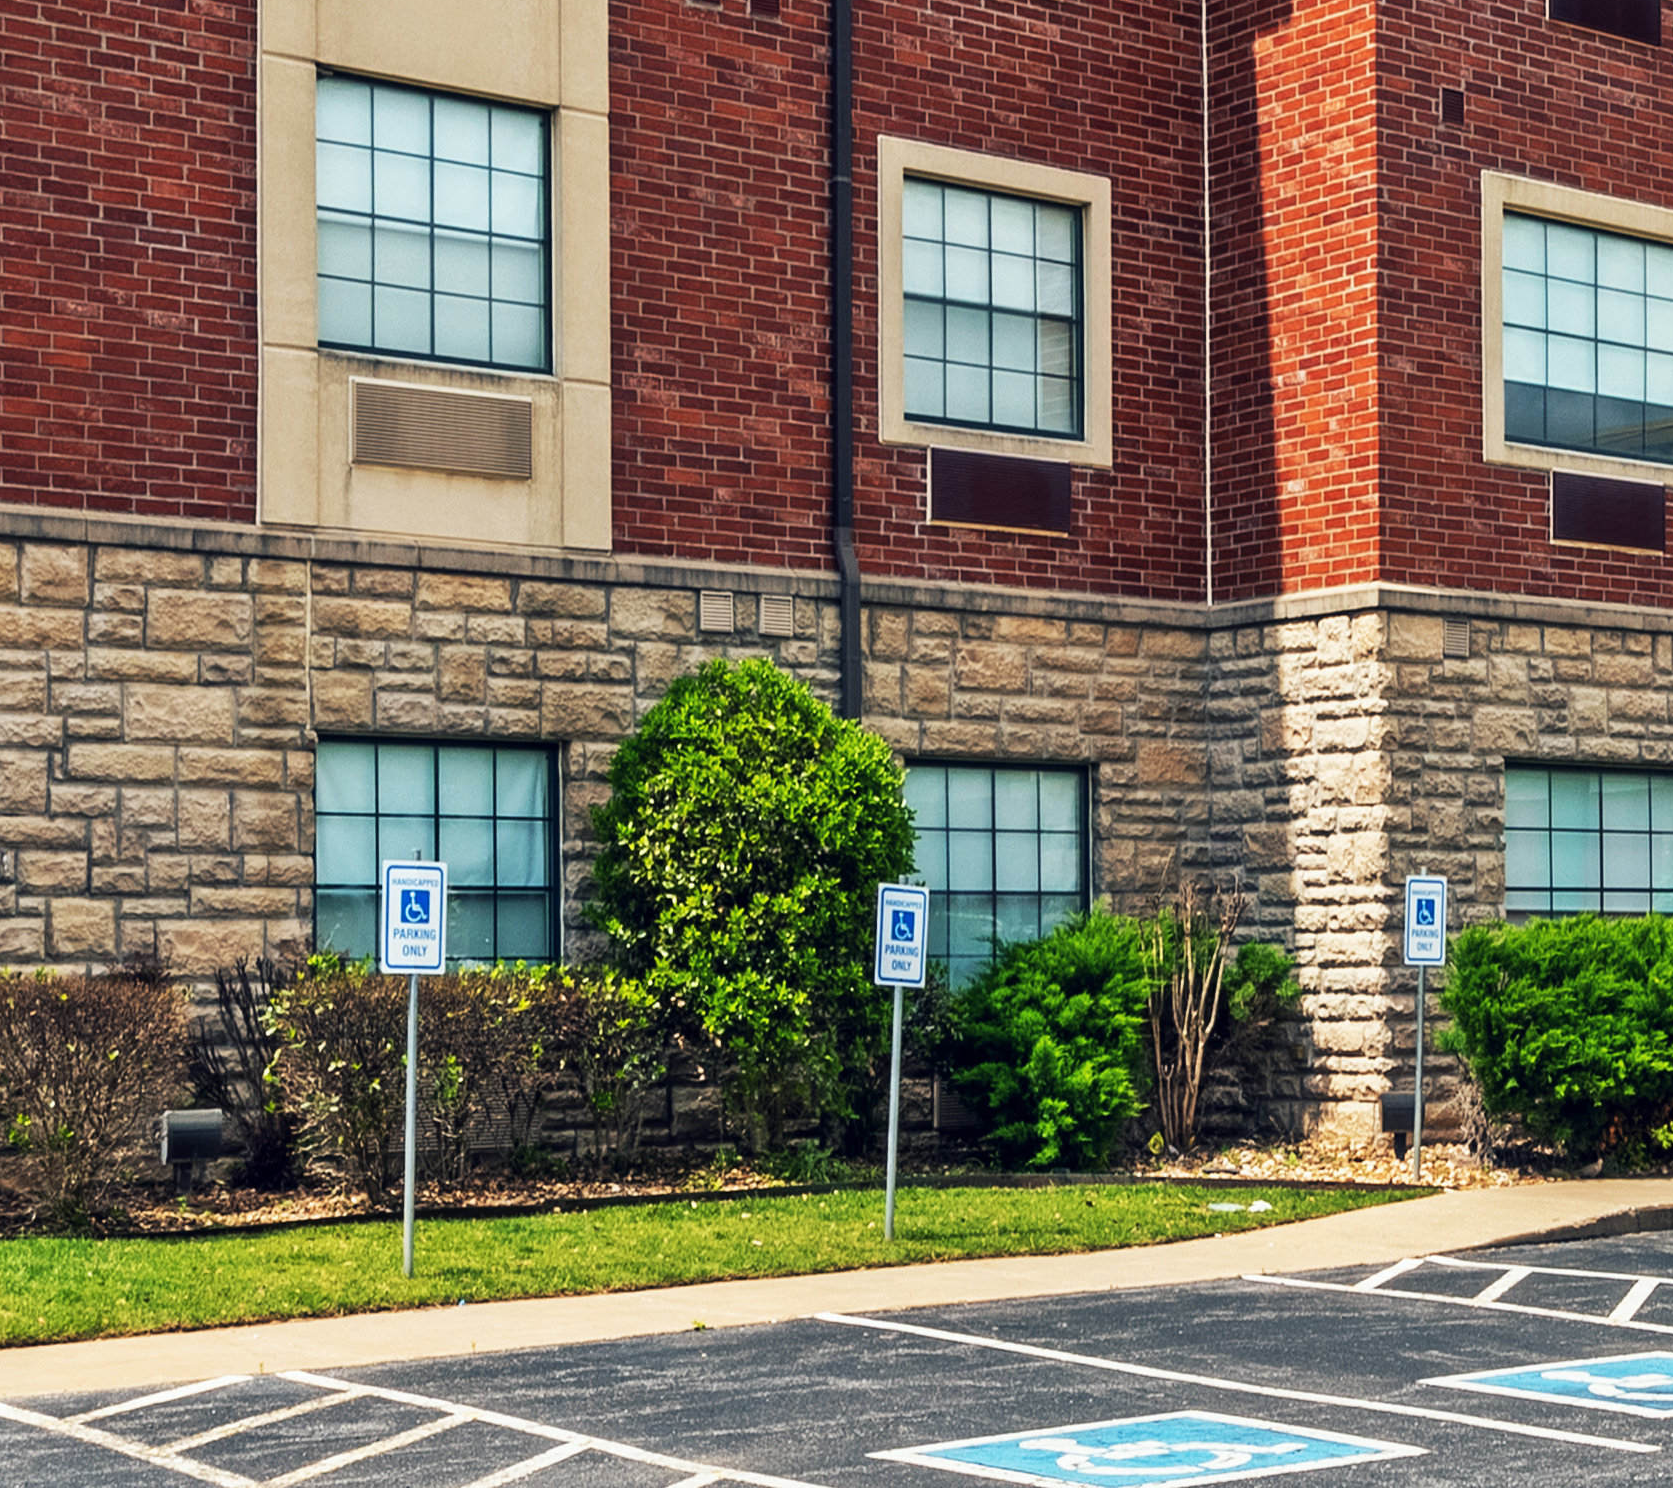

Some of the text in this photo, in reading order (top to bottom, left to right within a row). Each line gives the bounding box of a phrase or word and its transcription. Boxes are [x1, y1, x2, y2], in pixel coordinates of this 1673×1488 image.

[392, 877, 439, 887] HANDICAPPED
[393, 928, 436, 940] PARKING
[1412, 929, 1439, 938] PARKING
[402, 945, 428, 957] ONLY
[885, 944, 919, 957] PARKING
[1417, 942, 1433, 952] ONLY
[892, 959, 912, 971] ONLY
